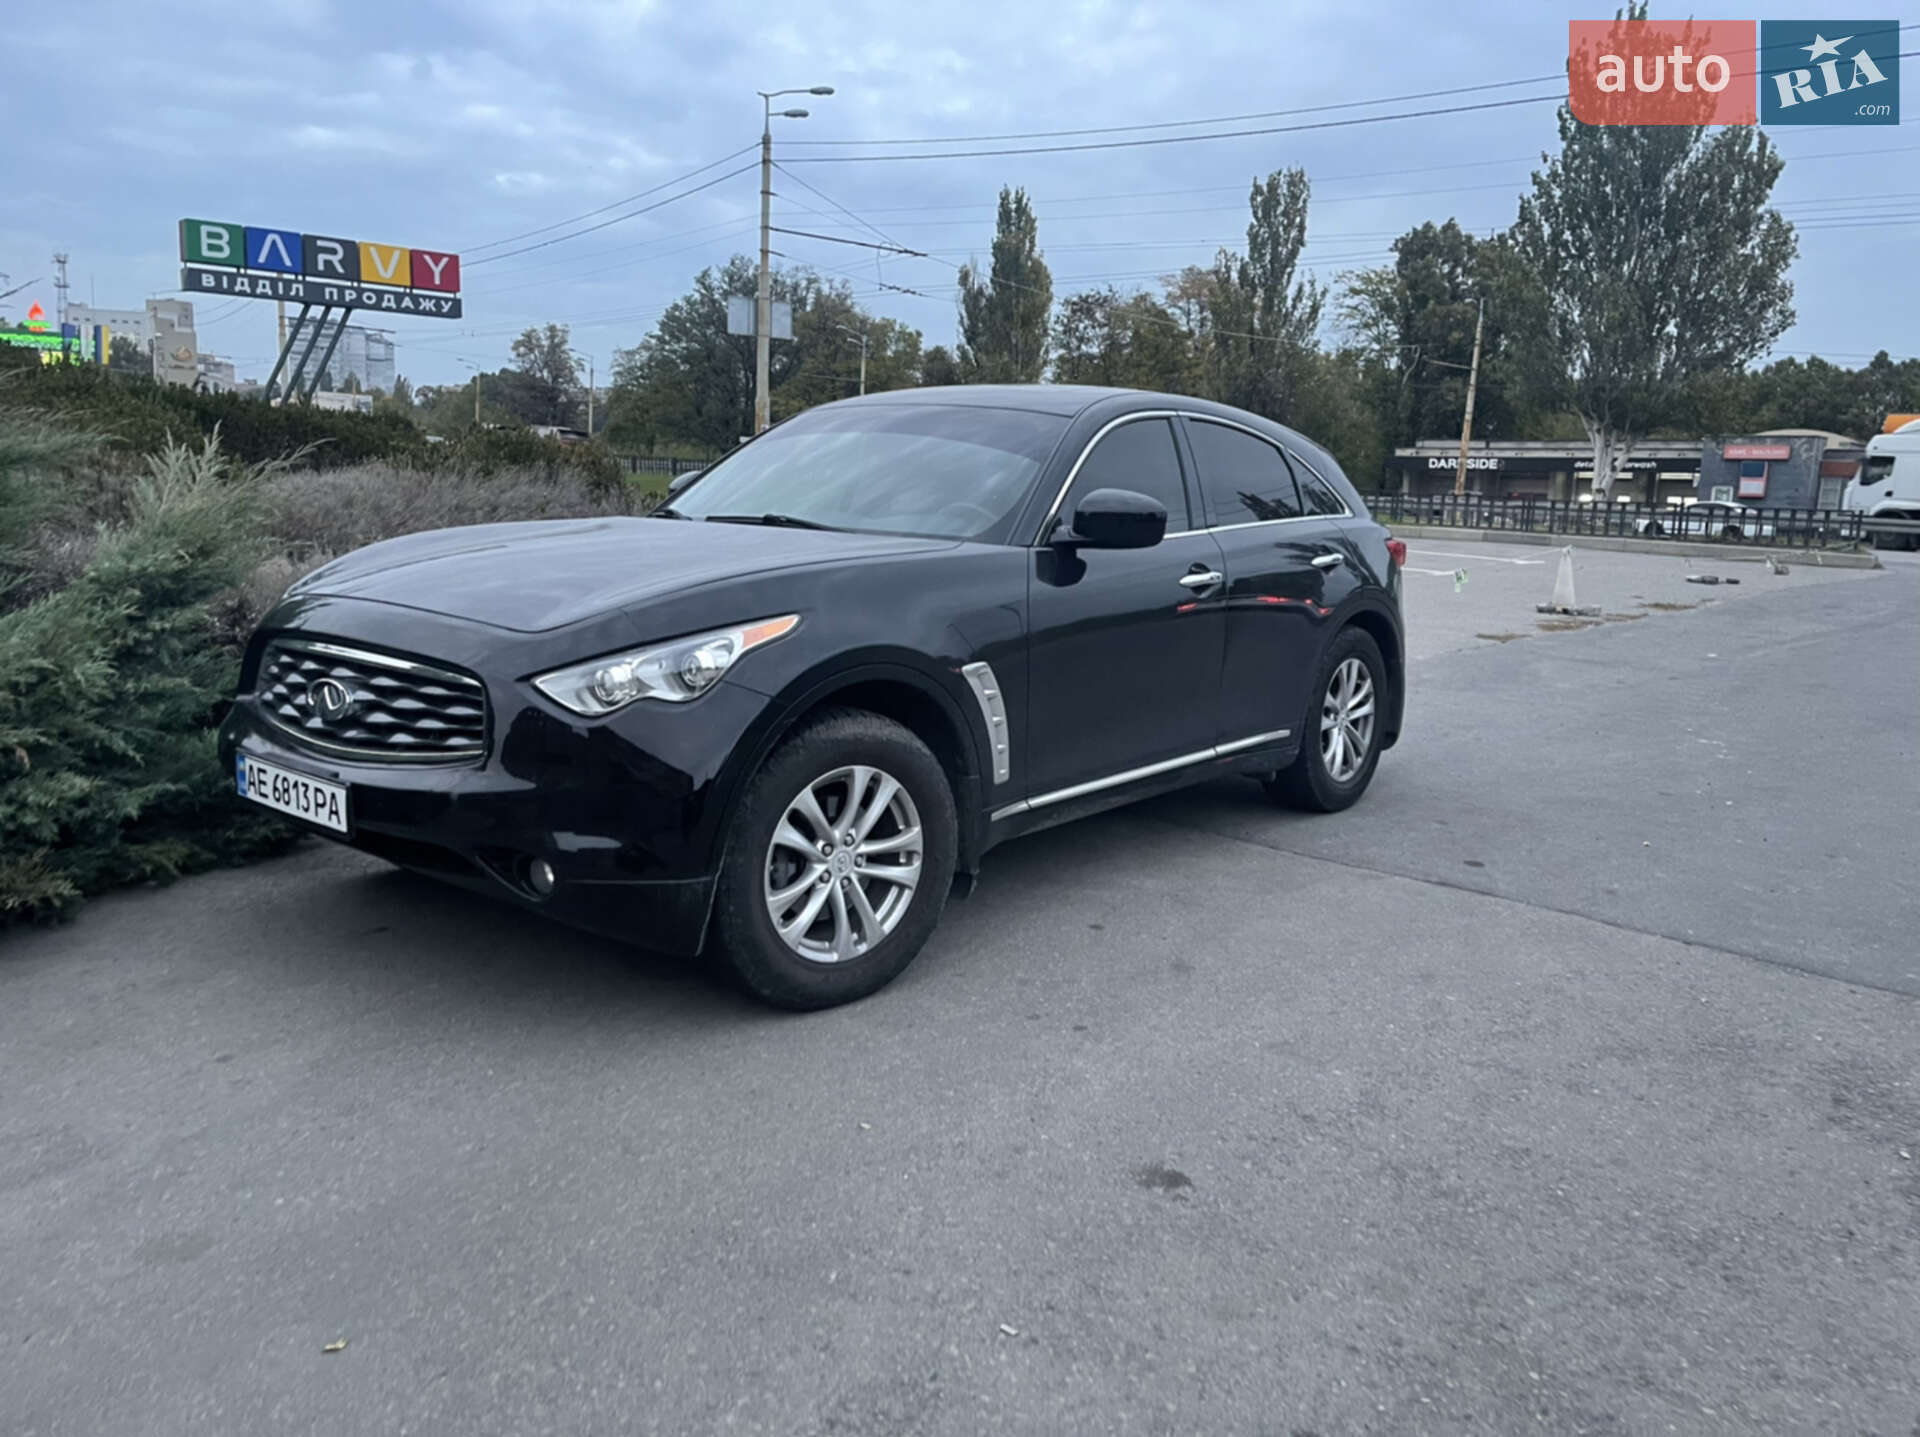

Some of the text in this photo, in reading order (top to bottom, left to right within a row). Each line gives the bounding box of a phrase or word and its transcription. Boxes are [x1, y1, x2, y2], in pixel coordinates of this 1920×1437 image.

[200, 225, 449, 285] BARVY
[201, 274, 453, 313] ВІДДІЛ ПРОДАЖУ
[1428, 458, 1498, 469] DARSIDE
[247, 764, 341, 825] AE 6813 PA
